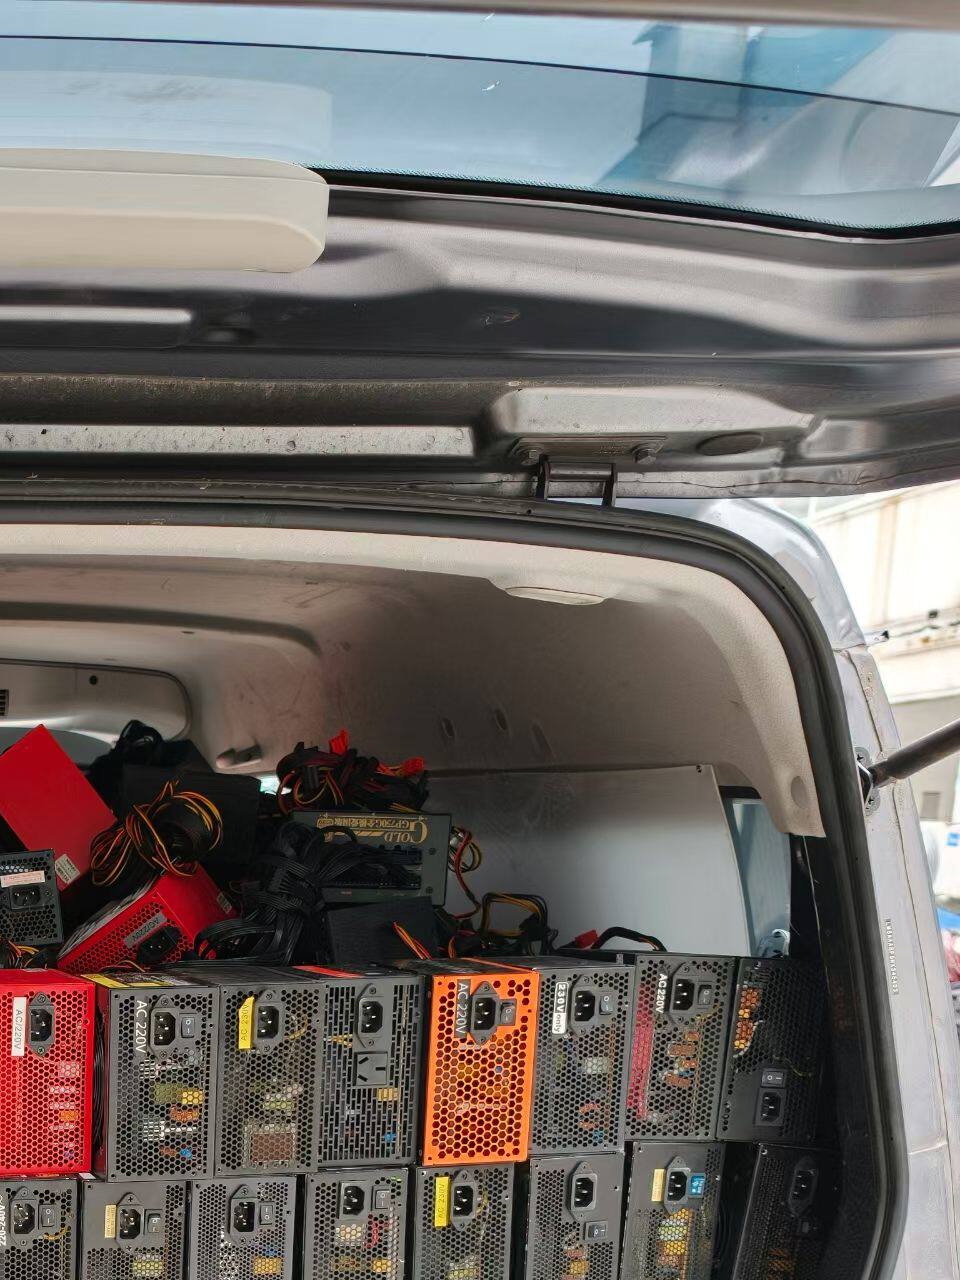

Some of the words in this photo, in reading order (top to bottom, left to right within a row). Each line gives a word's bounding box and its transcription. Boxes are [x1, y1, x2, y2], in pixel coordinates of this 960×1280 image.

[458, 983, 468, 1000] AC
[556, 983, 566, 1012] 230V
[136, 1000, 147, 1018] AC
[241, 1002, 249, 1026] 230V
[456, 1003, 468, 1034] 220V
[14, 1008, 23, 1050] AC/220V
[553, 1014, 562, 1033] only
[135, 1022, 147, 1053] 220V
[241, 1030, 248, 1042] AC
